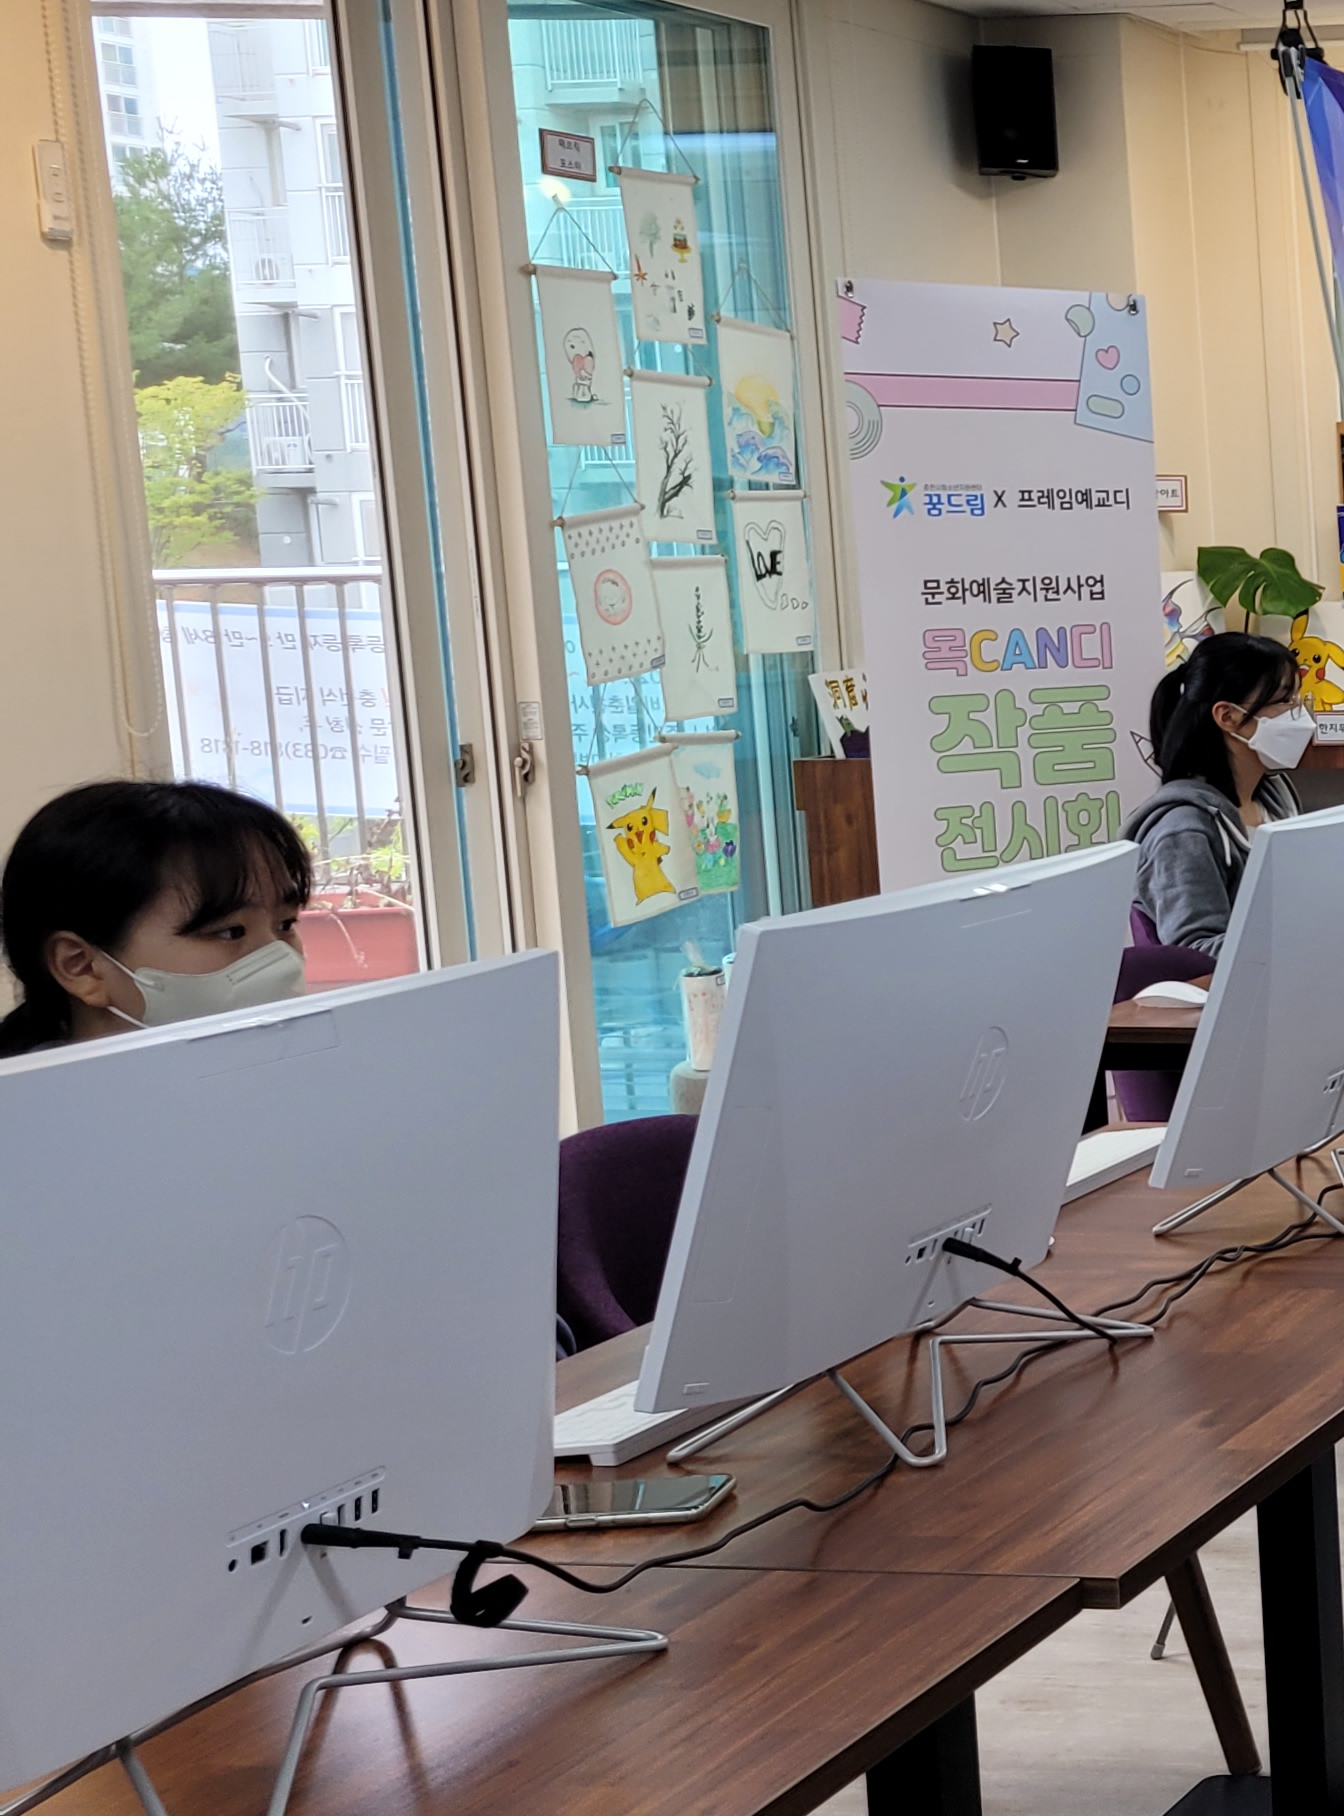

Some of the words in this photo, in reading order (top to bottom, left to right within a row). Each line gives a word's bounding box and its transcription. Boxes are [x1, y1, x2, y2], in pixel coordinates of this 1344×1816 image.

[923, 493, 985, 517] 꿈드림
[1017, 488, 1131, 511] 프레임예교디
[746, 540, 783, 582] LOVE
[921, 574, 1106, 606] 문화예술지원사업
[922, 622, 1113, 677] 목CAN디
[928, 685, 1117, 789] 작품
[934, 791, 1121, 872] 전시회
